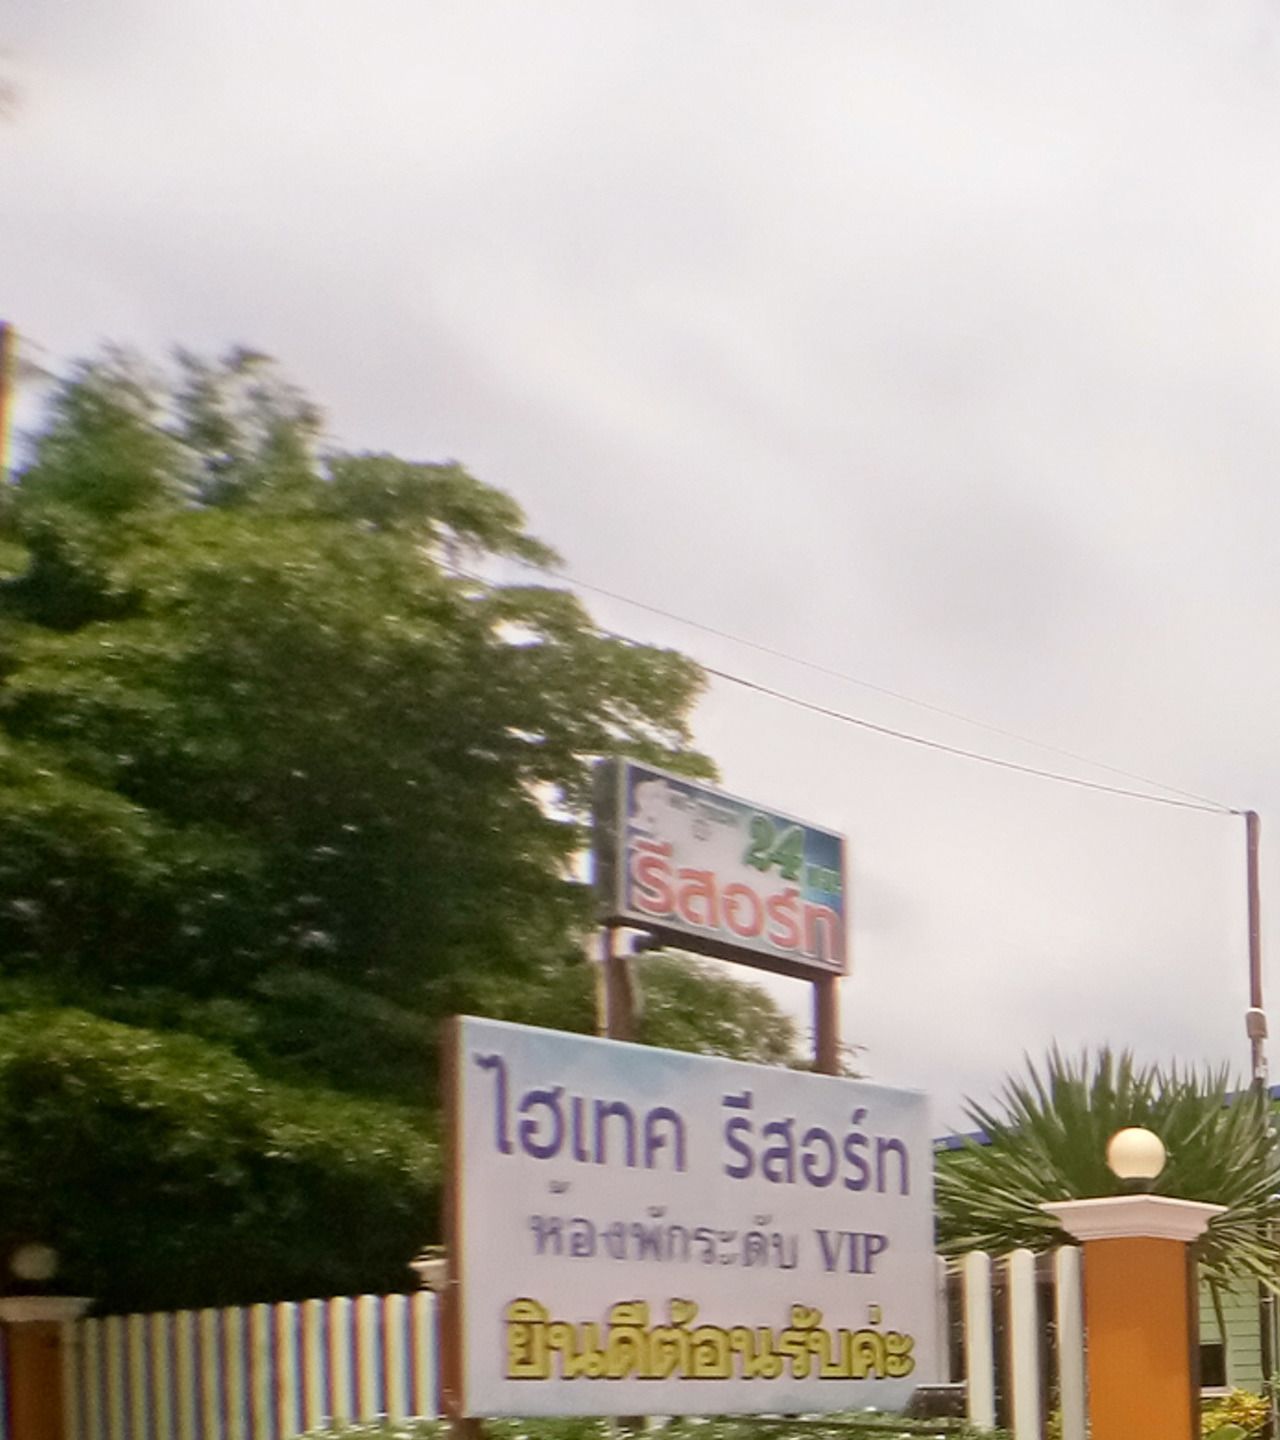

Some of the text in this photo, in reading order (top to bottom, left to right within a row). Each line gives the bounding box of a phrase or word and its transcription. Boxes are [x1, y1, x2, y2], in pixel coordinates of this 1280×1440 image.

[632, 838, 845, 963] รีสอร์ท
[473, 1053, 910, 1196] ไฮเทค รีสอร์ท
[814, 1228, 890, 1275] VIP
[504, 1297, 916, 1380] ยินดีต้อนรับค่ะ
